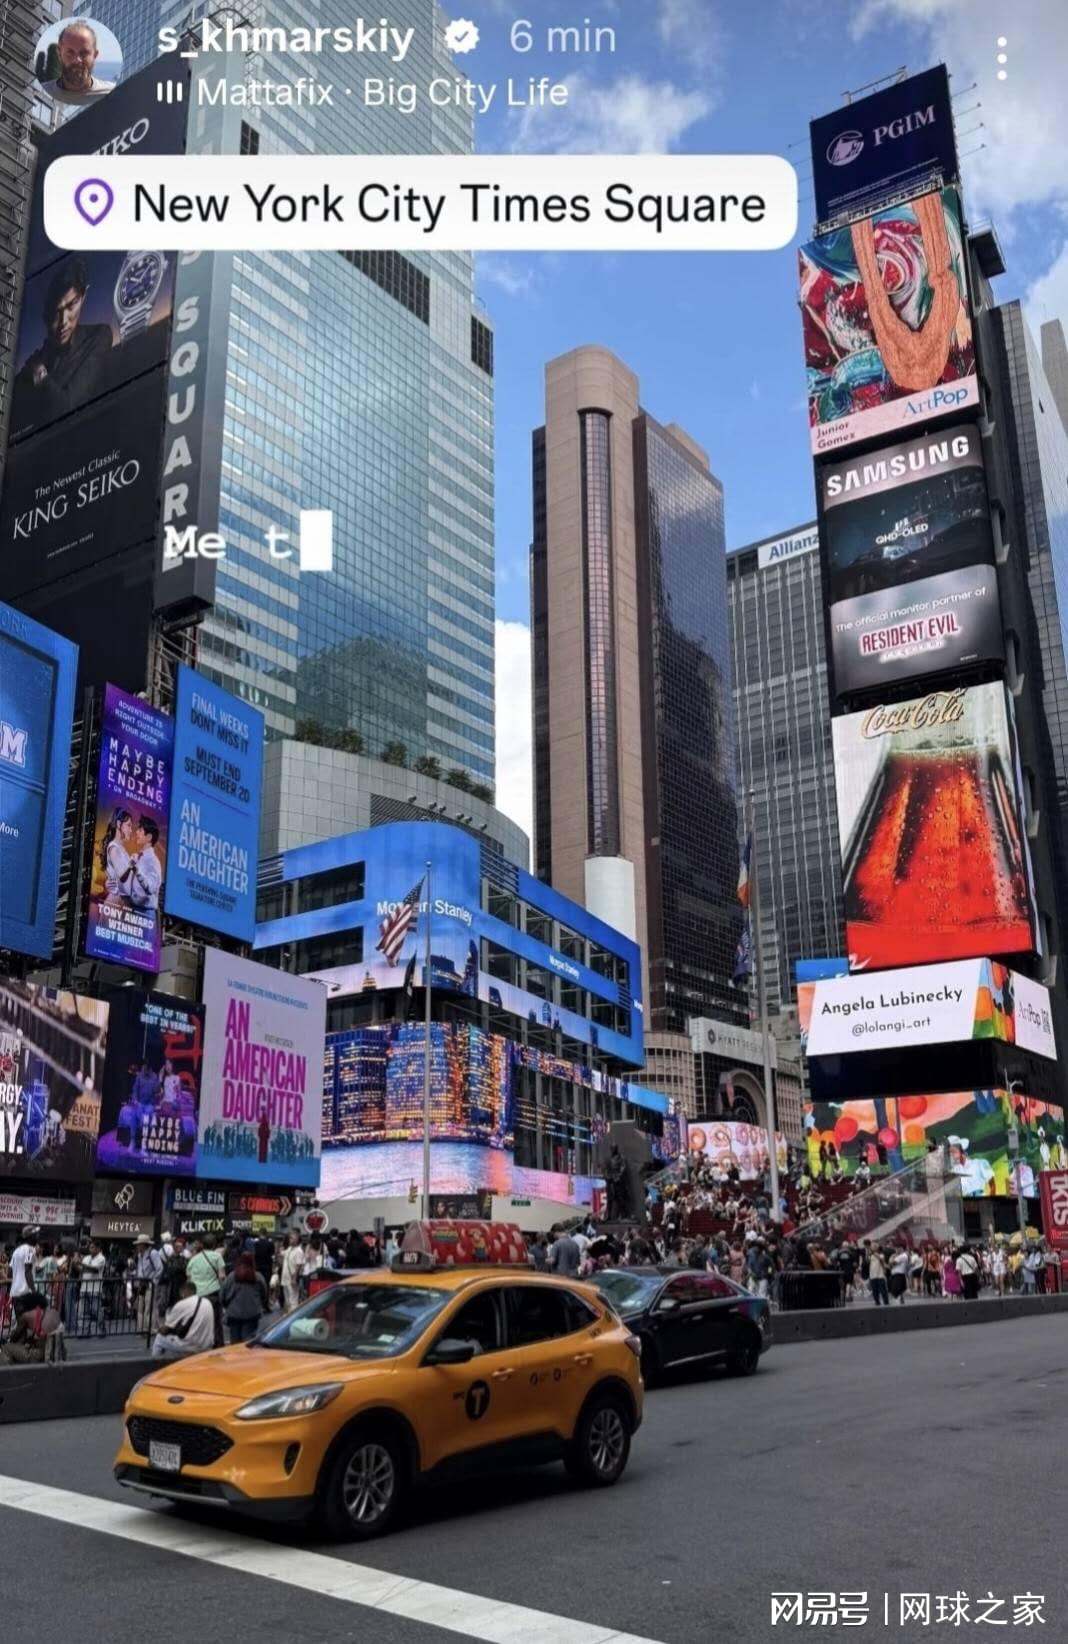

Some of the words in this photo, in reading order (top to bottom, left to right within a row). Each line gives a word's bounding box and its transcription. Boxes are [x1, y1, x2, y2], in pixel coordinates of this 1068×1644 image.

[872, 104, 936, 147] PGIM
[903, 387, 969, 420] ArtPop
[815, 421, 850, 440] Junior
[34, 485, 51, 499] The
[53, 468, 86, 491] Newest
[88, 449, 121, 473] Classic
[826, 435, 970, 497] SAMSUNG
[13, 494, 69, 540] KING
[76, 458, 140, 508] SEIKO
[768, 533, 819, 561] Allianz
[854, 612, 889, 630] official
[890, 602, 930, 621] monitor
[932, 592, 973, 611] partner
[974, 587, 987, 597] of
[861, 620, 924, 653] RESIDENT
[928, 613, 959, 637] EVIL
[191, 692, 217, 721] FINAL
[219, 710, 249, 740] WEEKS
[109, 752, 165, 788] HAPPY
[110, 737, 165, 775] MAYBE
[196, 746, 222, 772] MUST
[223, 761, 241, 781] END
[108, 768, 164, 804] ENDING
[184, 756, 237, 798] SEPTEMBER
[238, 786, 250, 802] 20
[181, 798, 201, 827] AN
[179, 822, 248, 871] AMERICAN
[178, 845, 249, 895] DAUGHTER
[98, 903, 124, 921] TONY
[124, 911, 155, 930] AWARD
[108, 918, 144, 939] WINNER
[434, 899, 473, 927] Stanley
[95, 925, 116, 942] BEST
[117, 931, 154, 952] MUSICAL
[821, 995, 875, 1017] Angela
[879, 985, 963, 1009] Lubinecky
[225, 998, 251, 1042] AN
[851, 1017, 932, 1038] @lolangi_art
[222, 1038, 307, 1095] AMERICAN
[143, 1113, 180, 1130] MAYBE
[222, 1079, 304, 1131] DAUGHTER
[141, 1137, 179, 1152] ENDING
[142, 1126, 180, 1141] HAPPY
[174, 1188, 203, 1203] BLUE
[207, 1191, 225, 1204] FIN
[107, 1221, 142, 1232] HEYTEA
[181, 1218, 225, 1233] KLIKTIX
